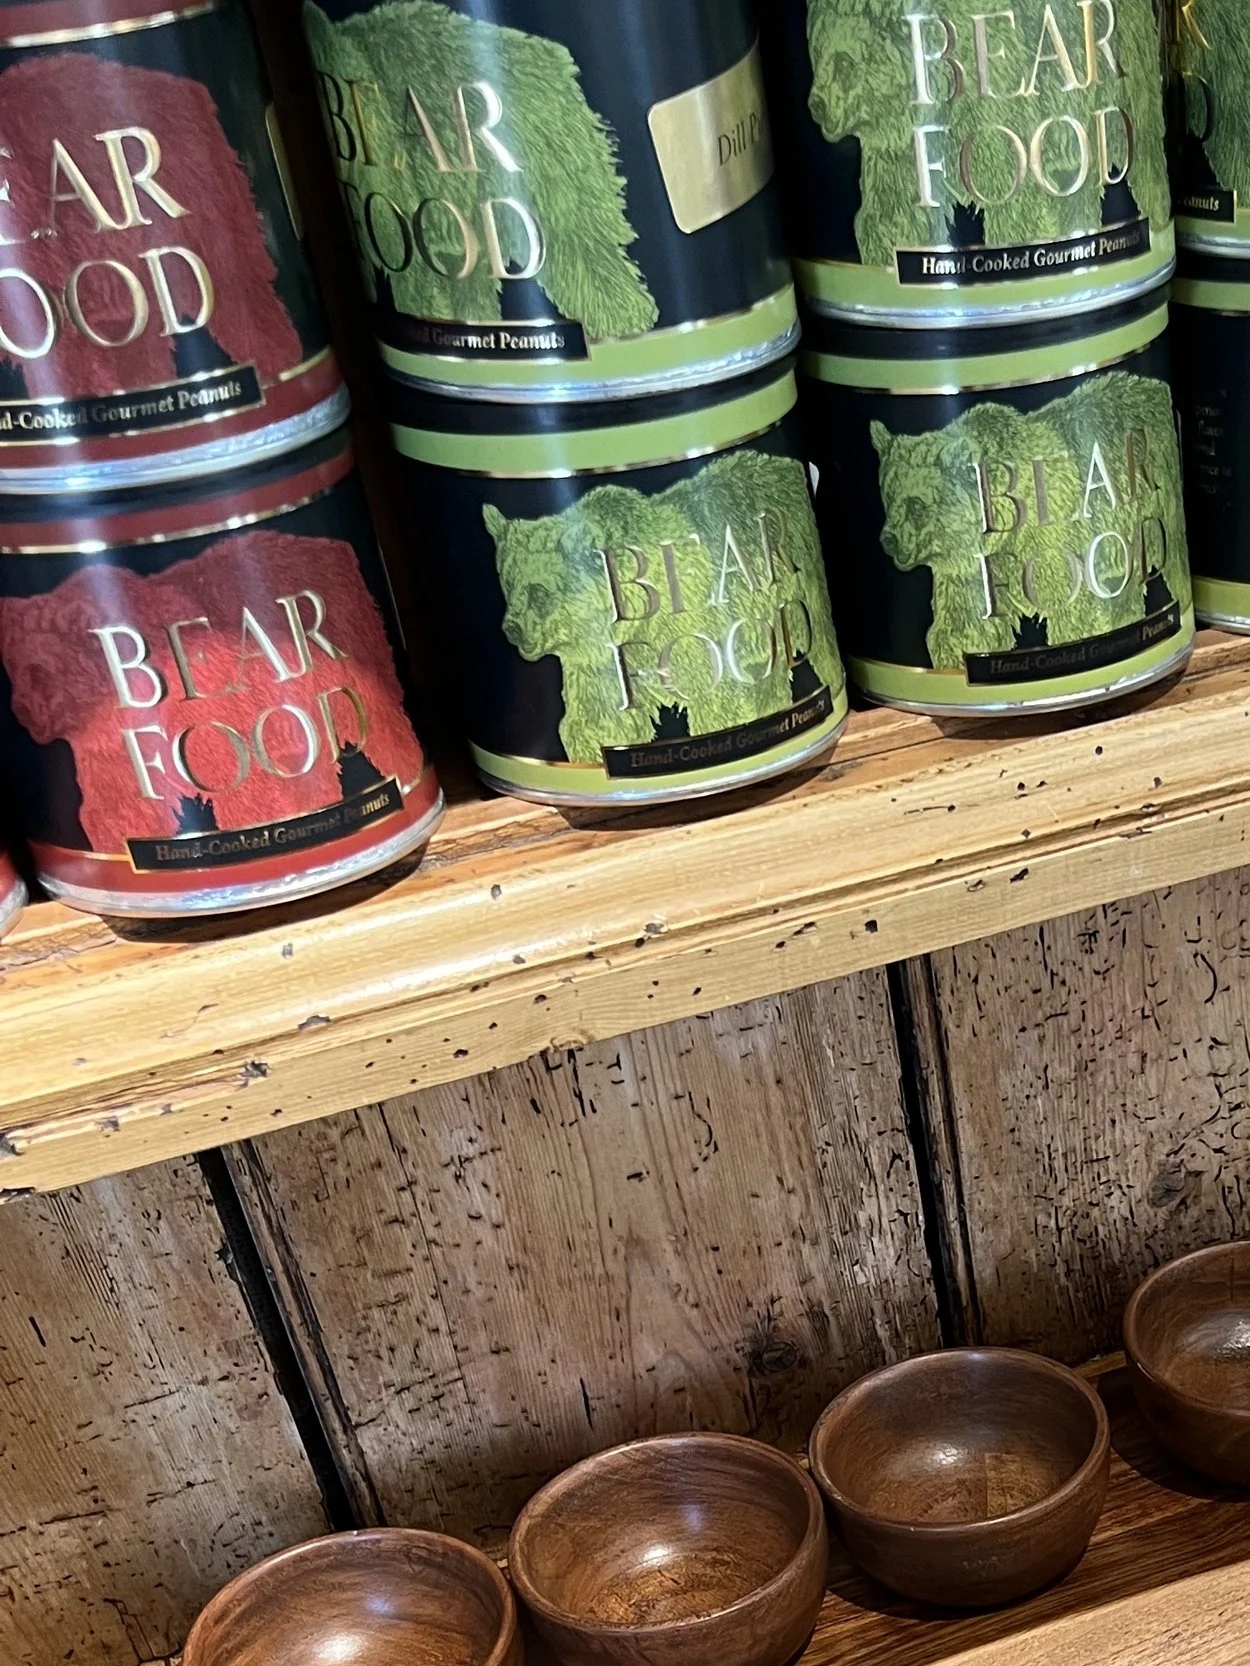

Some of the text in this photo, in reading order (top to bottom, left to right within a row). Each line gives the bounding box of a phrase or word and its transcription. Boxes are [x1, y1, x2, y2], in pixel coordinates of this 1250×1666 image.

[904, 0, 1127, 106] BEAR
[717, 120, 747, 167] Dill
[913, 106, 1134, 208] FOOD
[922, 230, 1141, 275] Hand-Cooked Gourmet Peanuts
[499, 330, 565, 351] Peanuts
[92, 395, 174, 422] Gourmet
[177, 380, 242, 410] Peanuts
[971, 426, 1161, 536] BEAR
[591, 509, 800, 625] BEAR
[974, 515, 1167, 620] FOOD
[87, 589, 350, 710] BEAR
[606, 599, 814, 712] FOOD
[121, 686, 371, 801] FOOD
[630, 733, 733, 768] Hand-Cooked
[735, 715, 791, 749] Gourmet
[155, 830, 270, 862] Hand-Cooked
[272, 815, 342, 844] Gourmet
